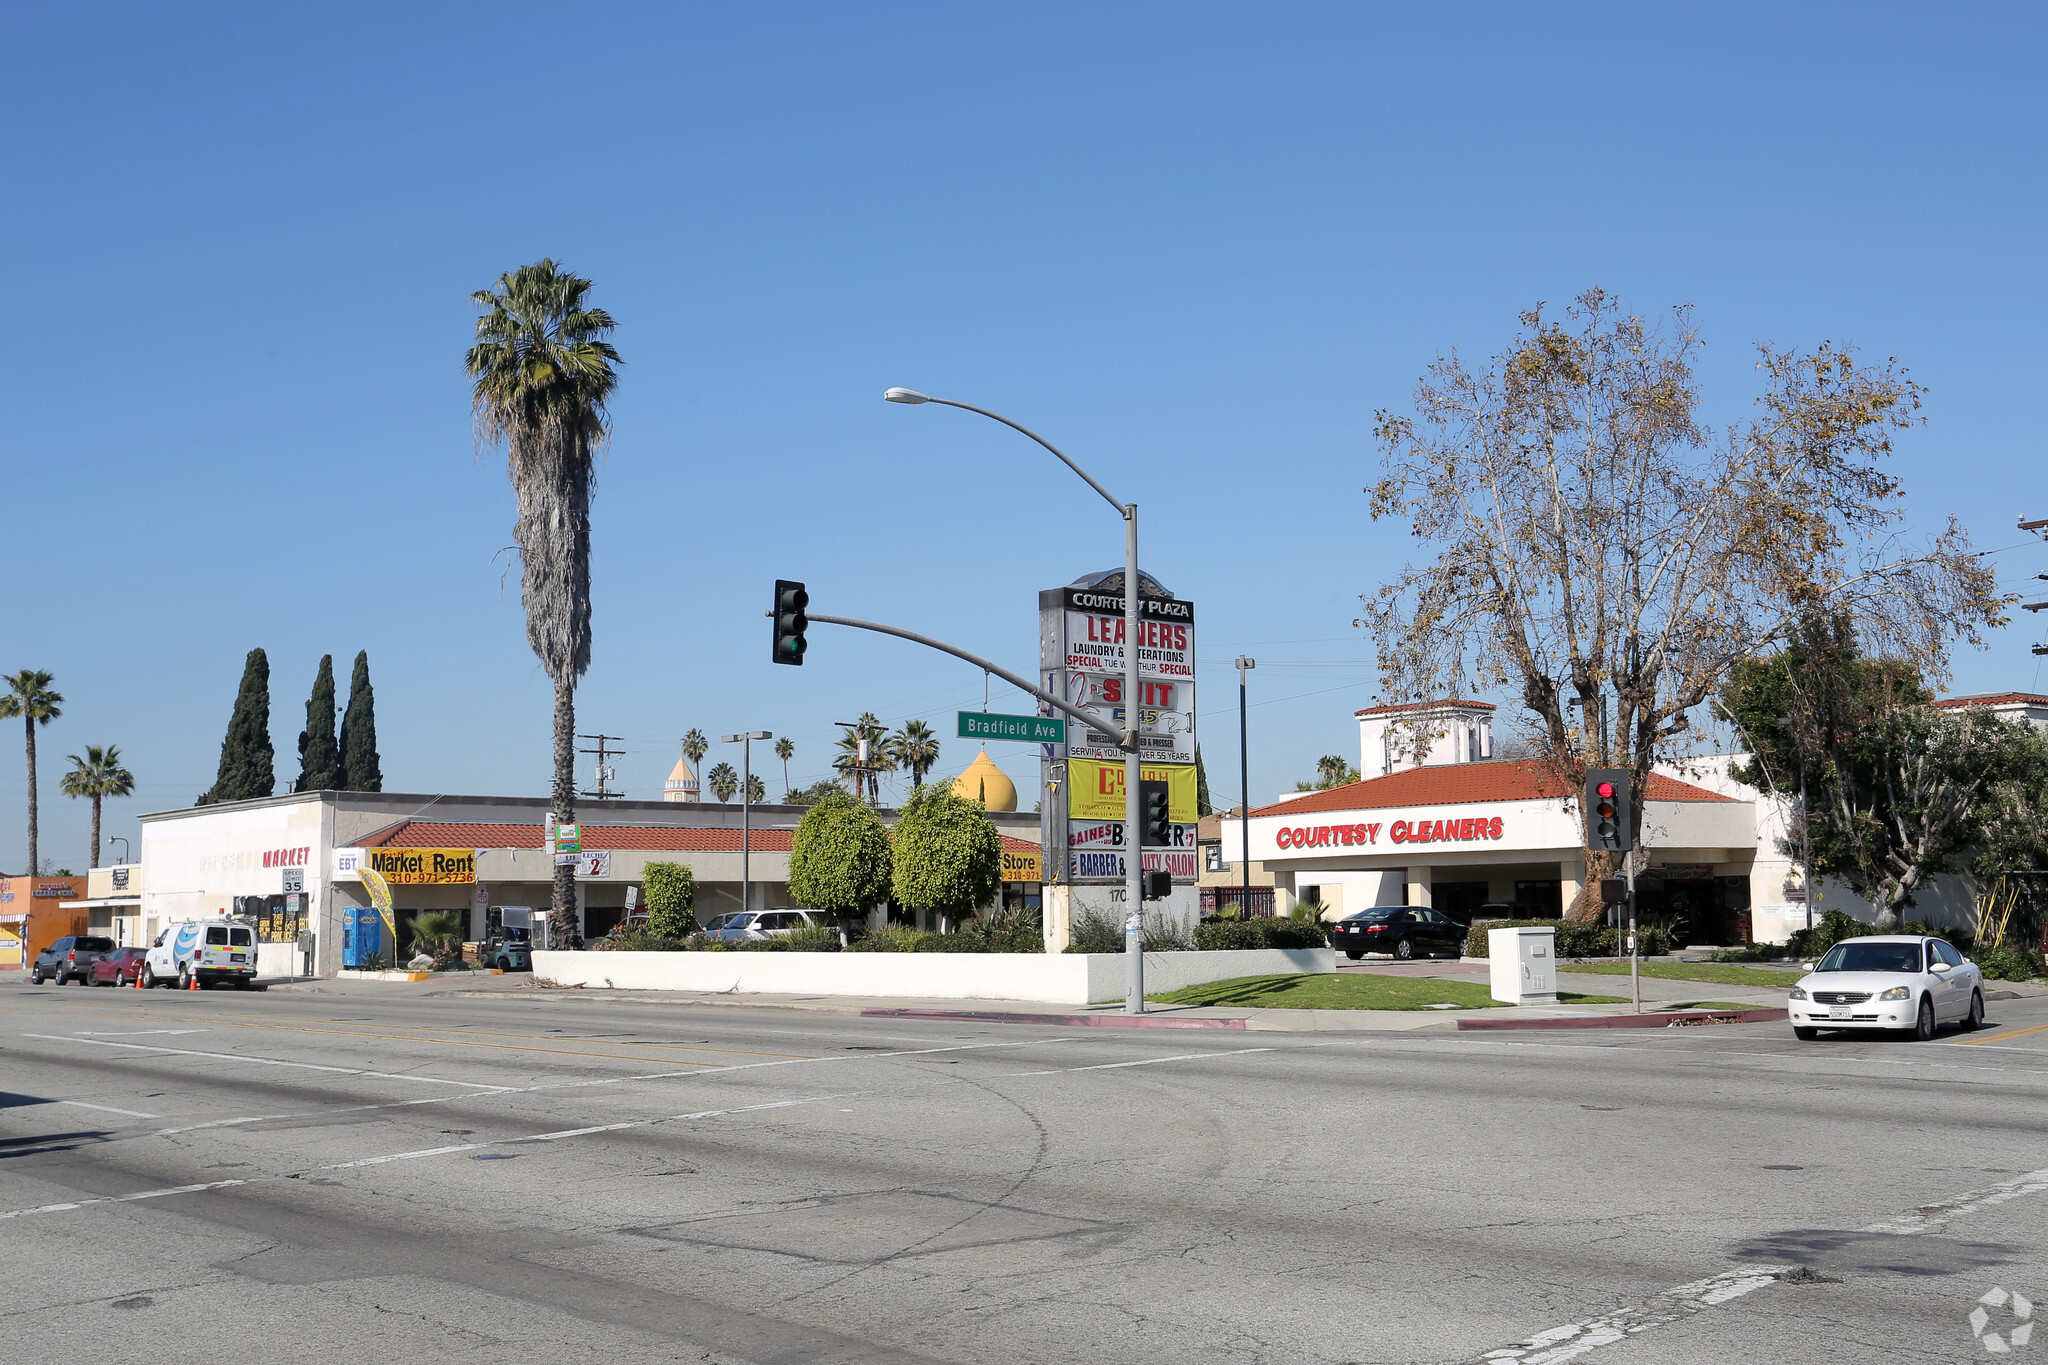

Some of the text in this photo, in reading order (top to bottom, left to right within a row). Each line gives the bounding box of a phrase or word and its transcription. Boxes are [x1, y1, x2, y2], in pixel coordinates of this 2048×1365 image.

[1073, 593, 1189, 618] COURTEY PLAZA
[1074, 643, 1184, 663] LAUNDRY & TERATIONS
[1067, 654, 1102, 668] SPECIAL
[1104, 658, 1118, 669] TUE
[1139, 662, 1157, 672] THUR
[1159, 663, 1192, 676] SPECIAL
[1103, 679, 1173, 706] SIT
[967, 718, 1056, 737] Bradfield Ave
[1152, 738, 1174, 748] PRESSED
[1071, 747, 1101, 757] SERVING
[1103, 748, 1118, 757] YOU
[1167, 752, 1190, 761] YEARS
[1068, 824, 1112, 847] GAINES
[1277, 816, 1504, 848] COURTESY CLEANERS
[263, 846, 310, 869] MARKET
[339, 857, 357, 871] EBT
[372, 853, 423, 873] Market
[433, 853, 474, 873] Rent
[1003, 853, 1036, 870] Store
[1080, 853, 1118, 877] BARBER
[1118, 856, 1127, 877] &
[1165, 853, 1195, 877] SALON
[285, 882, 302, 892] 35
[389, 872, 474, 884] 310-971-5736
